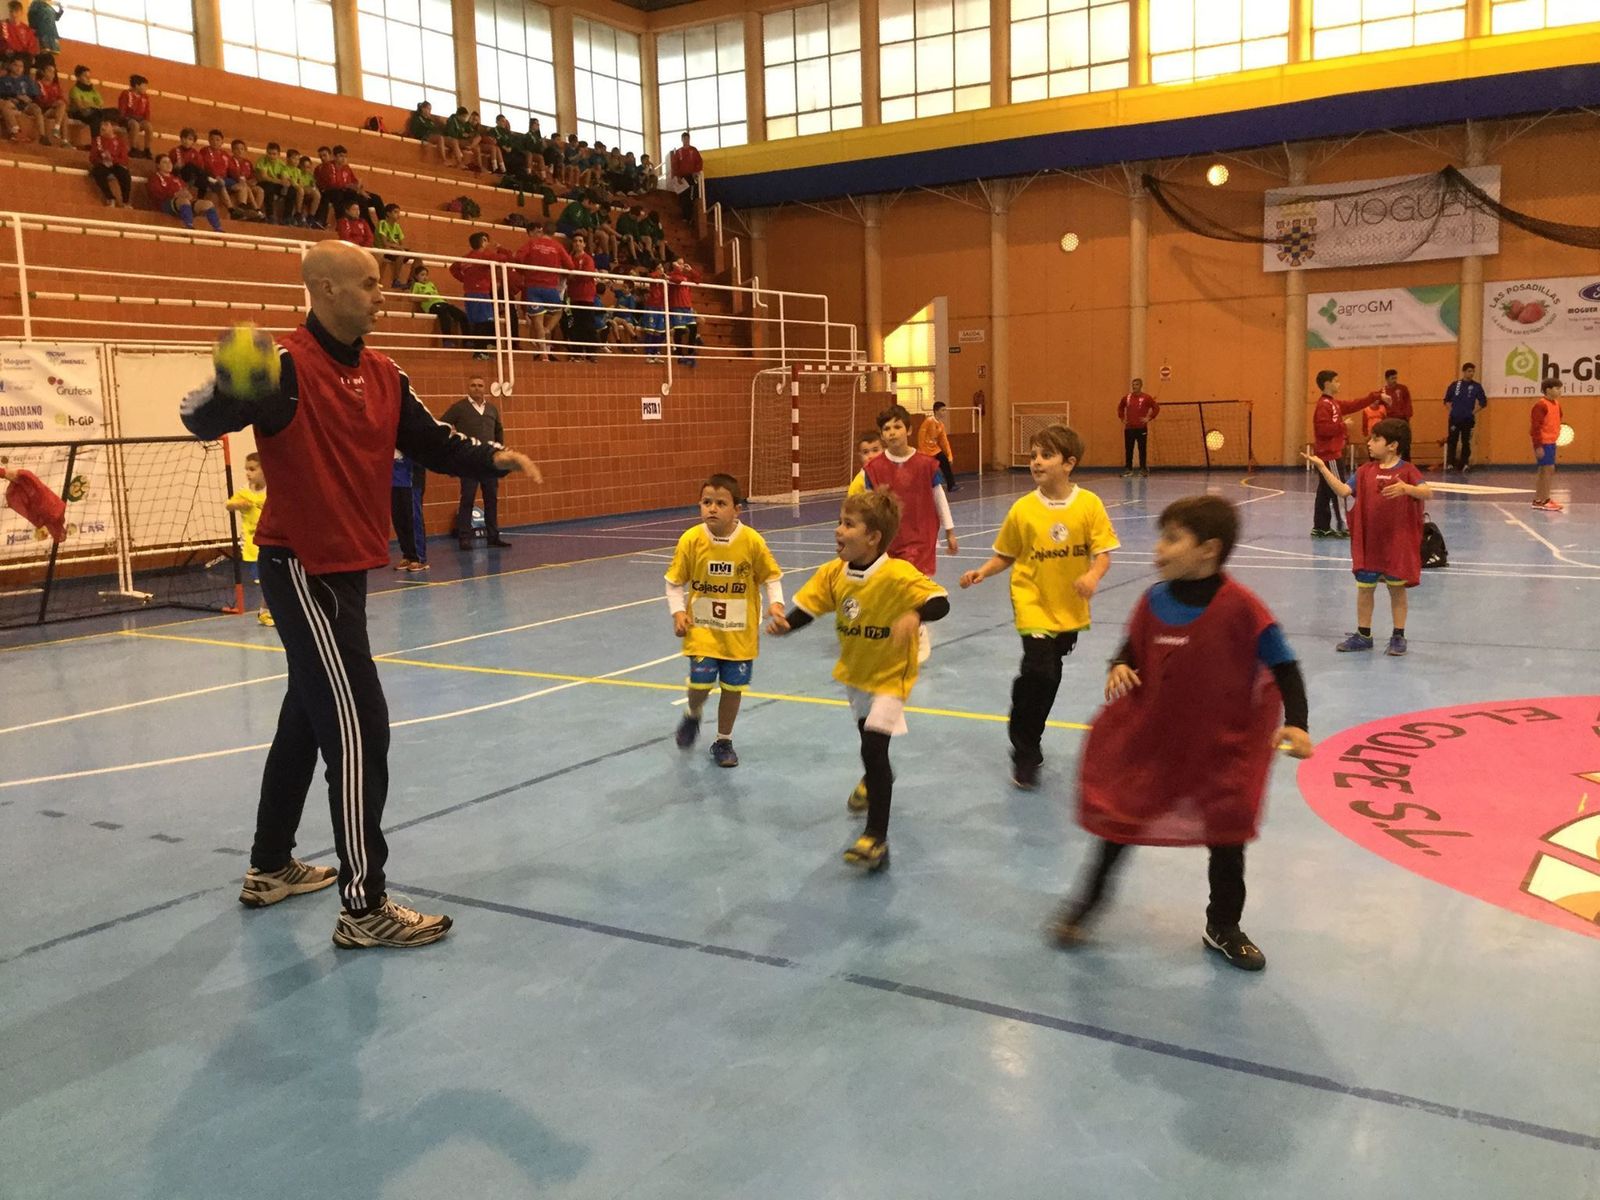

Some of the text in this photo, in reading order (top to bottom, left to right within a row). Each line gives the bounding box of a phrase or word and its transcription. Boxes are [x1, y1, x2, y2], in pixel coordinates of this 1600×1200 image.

[1489, 283, 1561, 309] LAS POSADILLAS
[1337, 300, 1393, 316] agroGM
[692, 580, 729, 594] Cajasol
[1333, 721, 1467, 795] GOLPE
